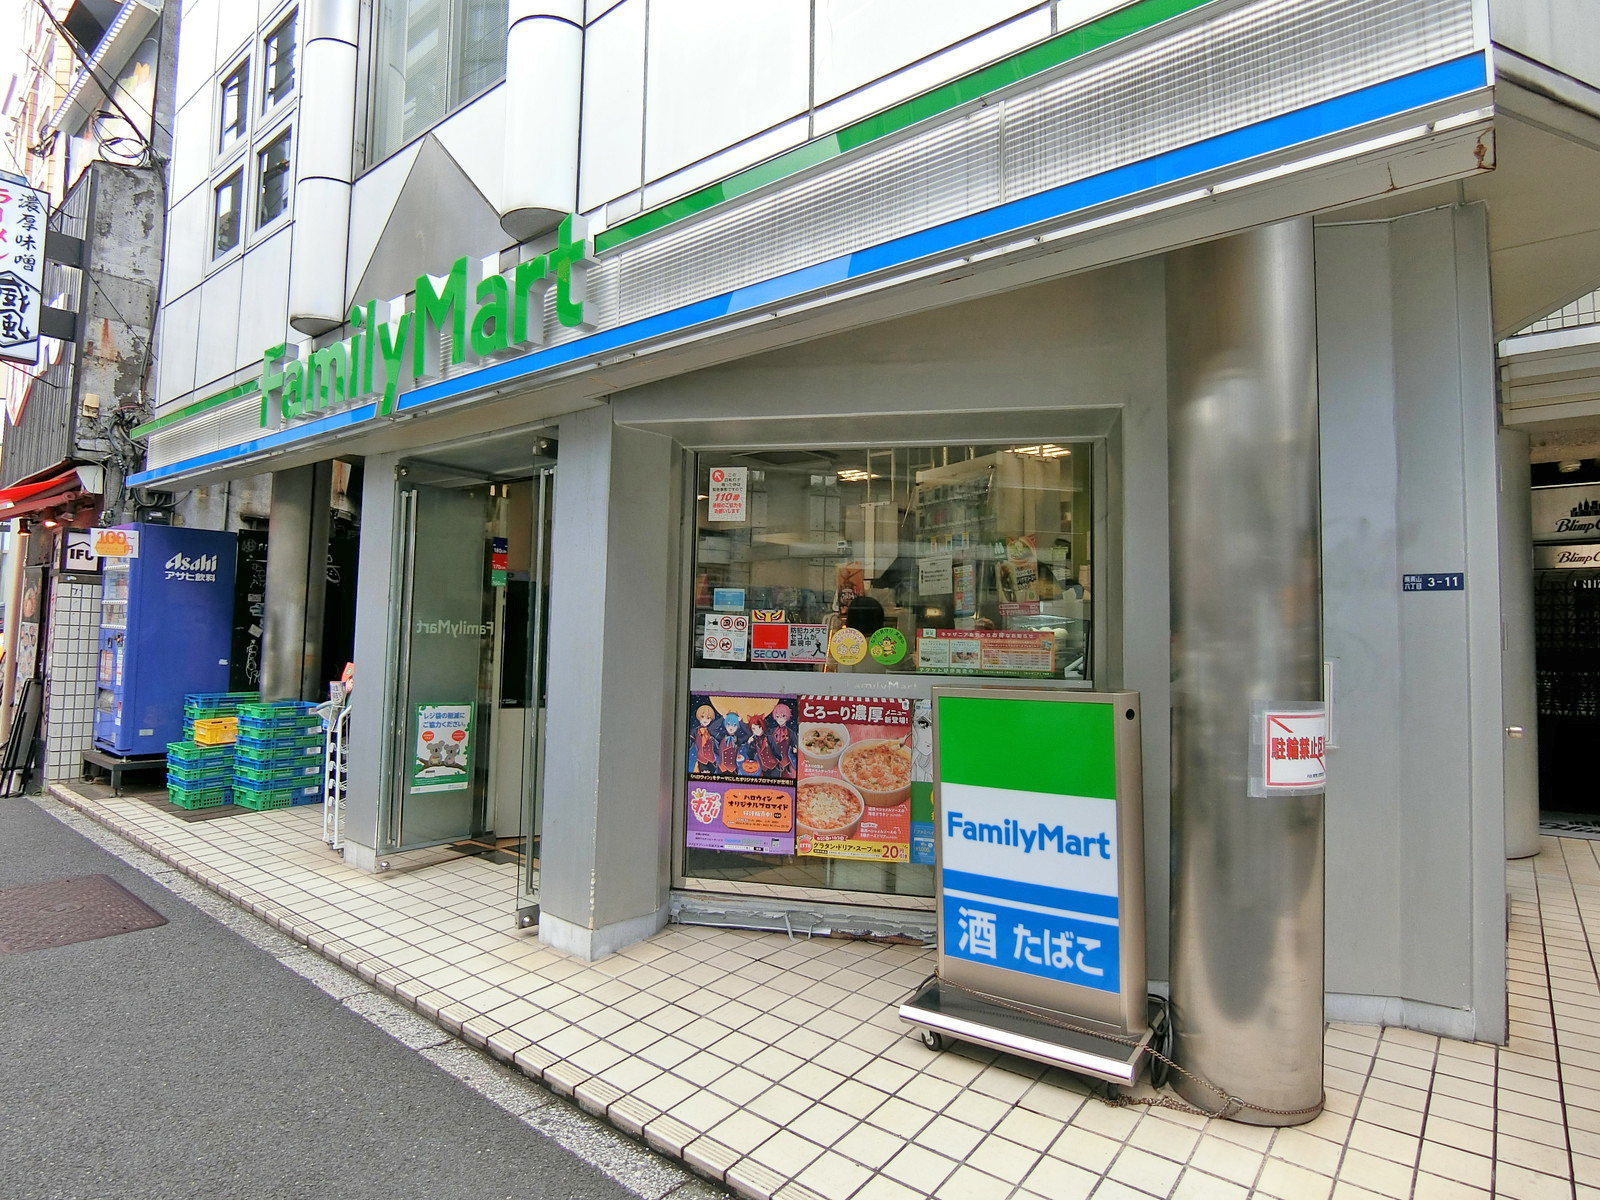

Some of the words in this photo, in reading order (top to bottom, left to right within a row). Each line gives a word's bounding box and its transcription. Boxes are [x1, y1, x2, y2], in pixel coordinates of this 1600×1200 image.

[14, 193, 41, 273] 濃厚味噌
[260, 212, 586, 429] FamilyMart
[1555, 519, 1594, 533] Blimp
[165, 552, 217, 572] Asahi
[1557, 551, 1593, 564] Blimp
[164, 570, 216, 583] アサヒ飲料
[1427, 576, 1458, 587] 3-11
[790, 627, 827, 635] 防犯カメラで
[753, 650, 787, 659] SECOM
[423, 712, 466, 720] レジ袋の削減に
[803, 702, 884, 723] とろーり濃厚
[422, 721, 467, 729] ご協力ください。
[743, 794, 773, 802] ハロウィン
[727, 800, 789, 810] オリジナルブロマイド
[947, 811, 1111, 860] FamilyMart
[882, 844, 899, 859] 20
[957, 906, 997, 959] 酒
[1012, 923, 1104, 976] たばこ
